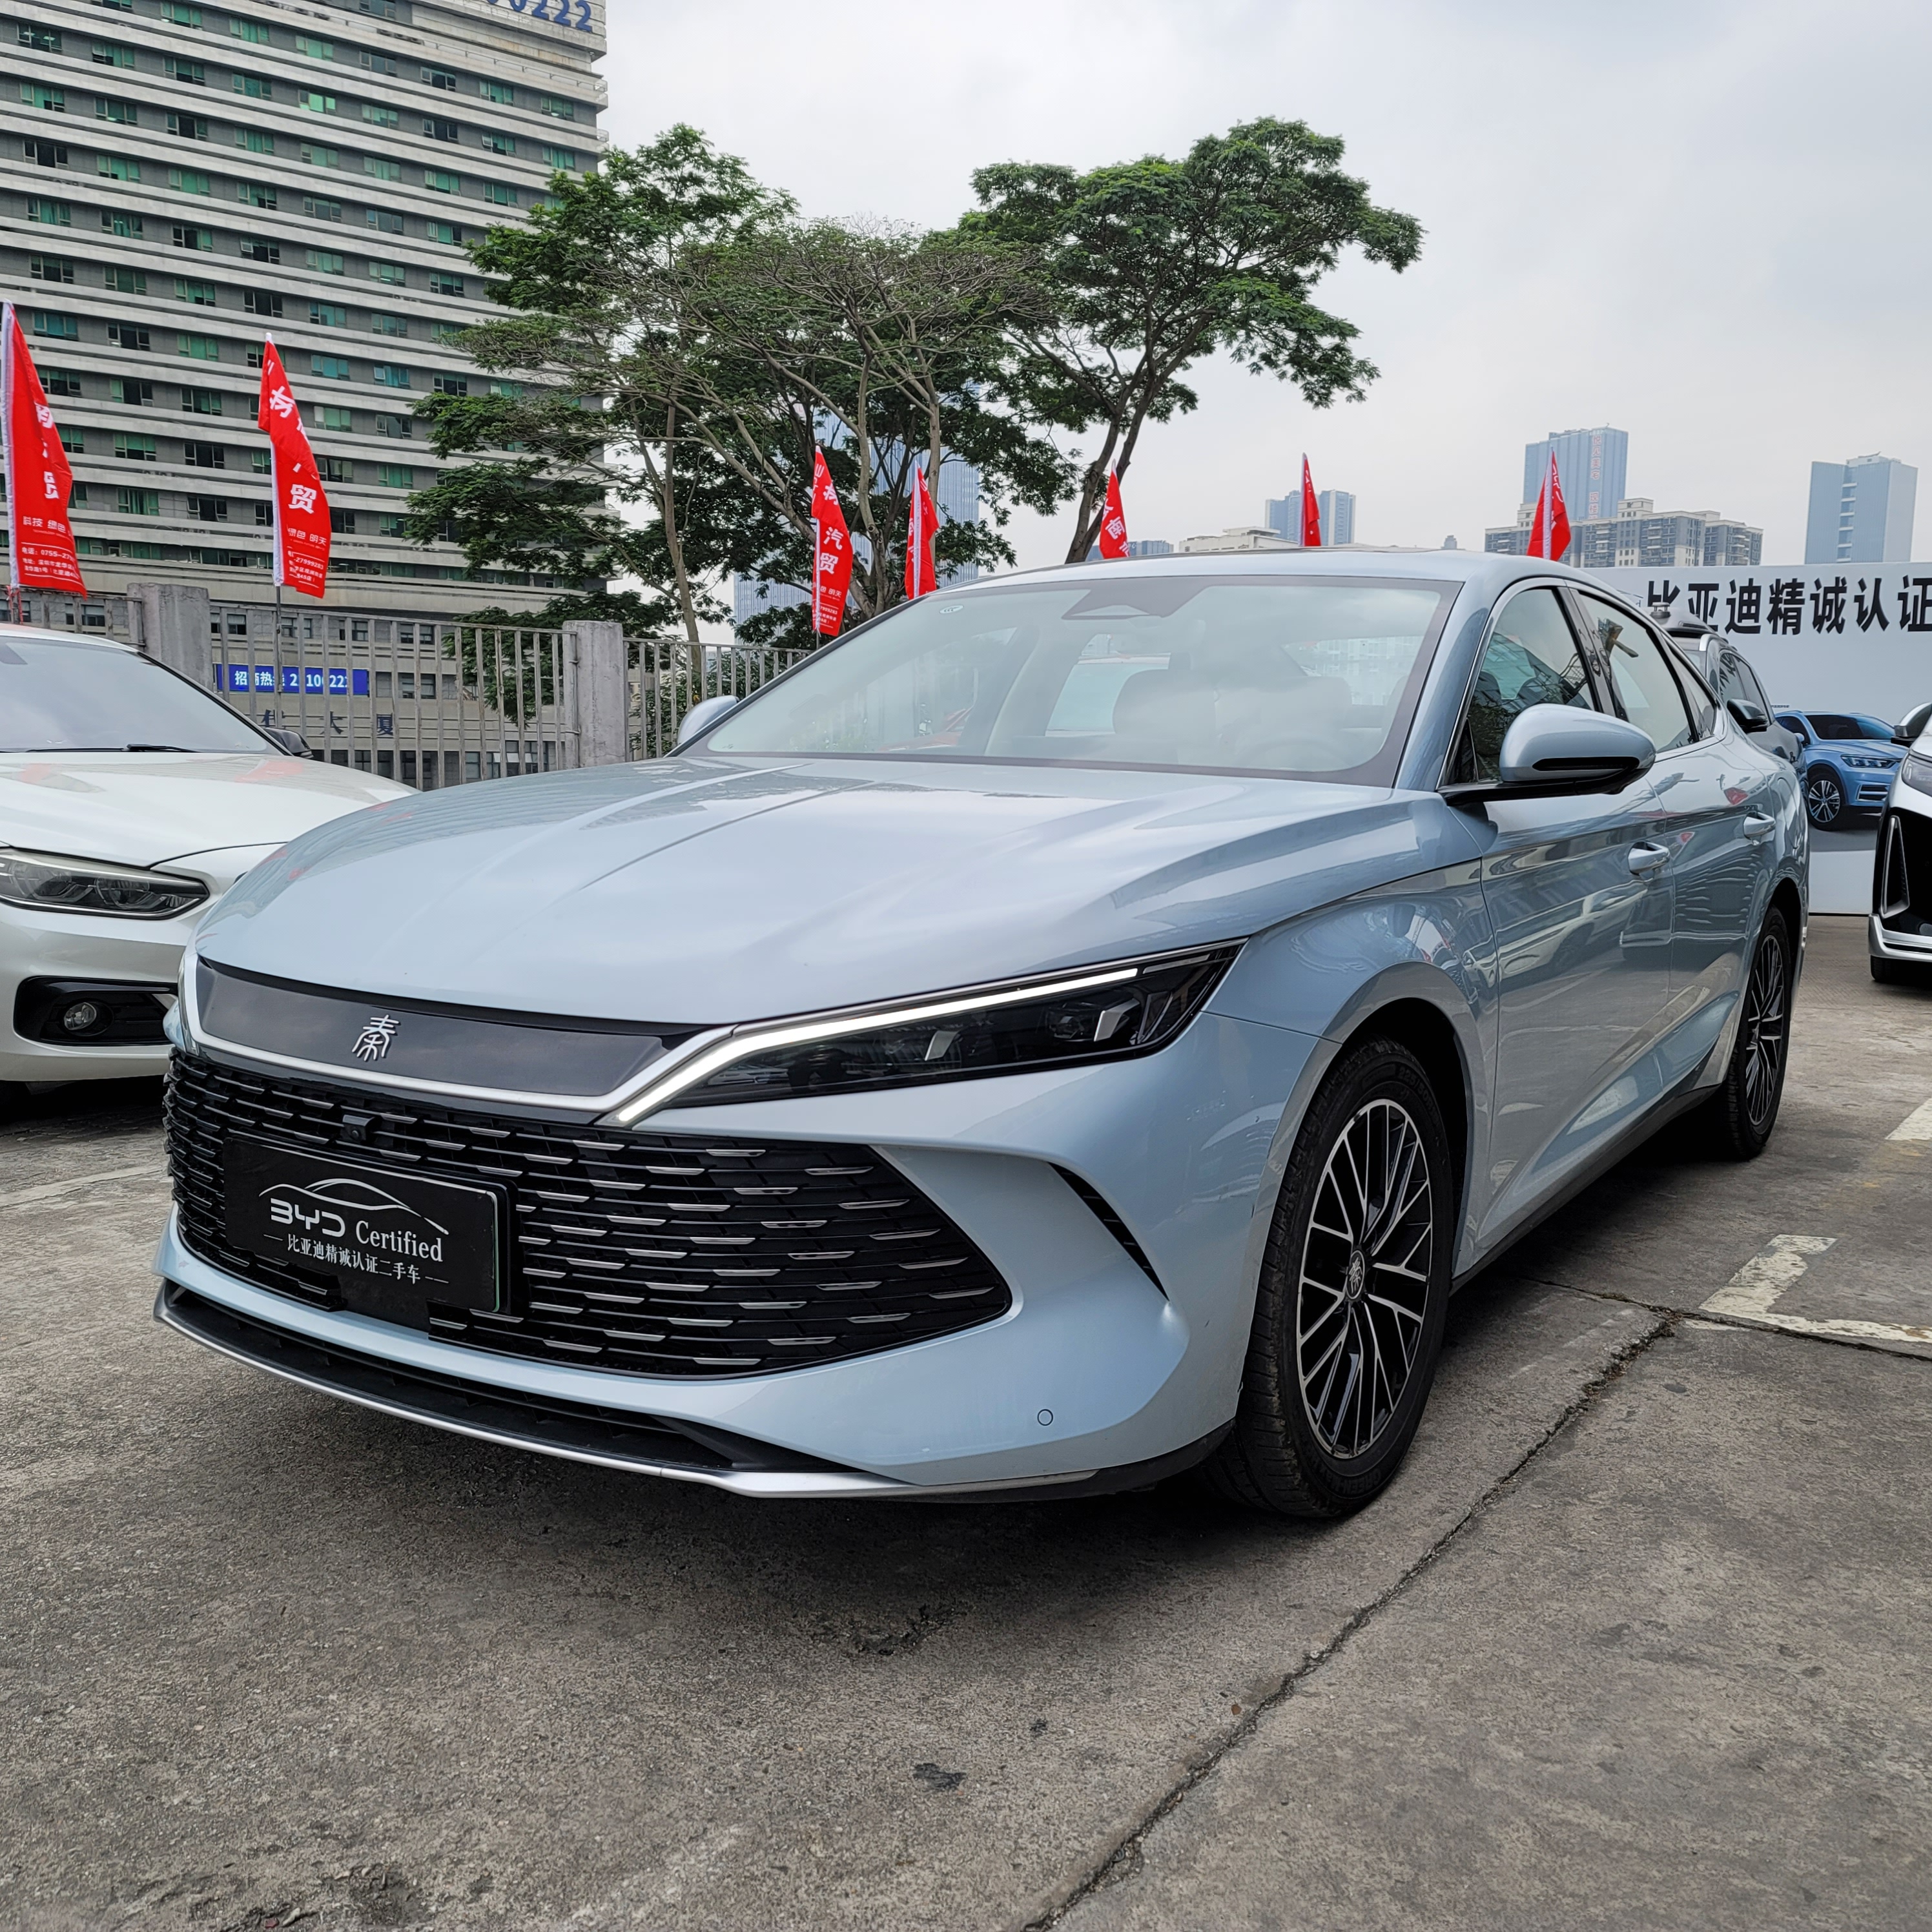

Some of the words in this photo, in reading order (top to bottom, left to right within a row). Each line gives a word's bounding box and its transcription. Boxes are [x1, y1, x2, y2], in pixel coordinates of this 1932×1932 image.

[488, 0, 592, 32] 222
[309, 533, 327, 546] 明天
[271, 1198, 345, 1237] BYD
[356, 1220, 443, 1262] Certified
[287, 1233, 421, 1284] 比亚迪精诚认证二手车
